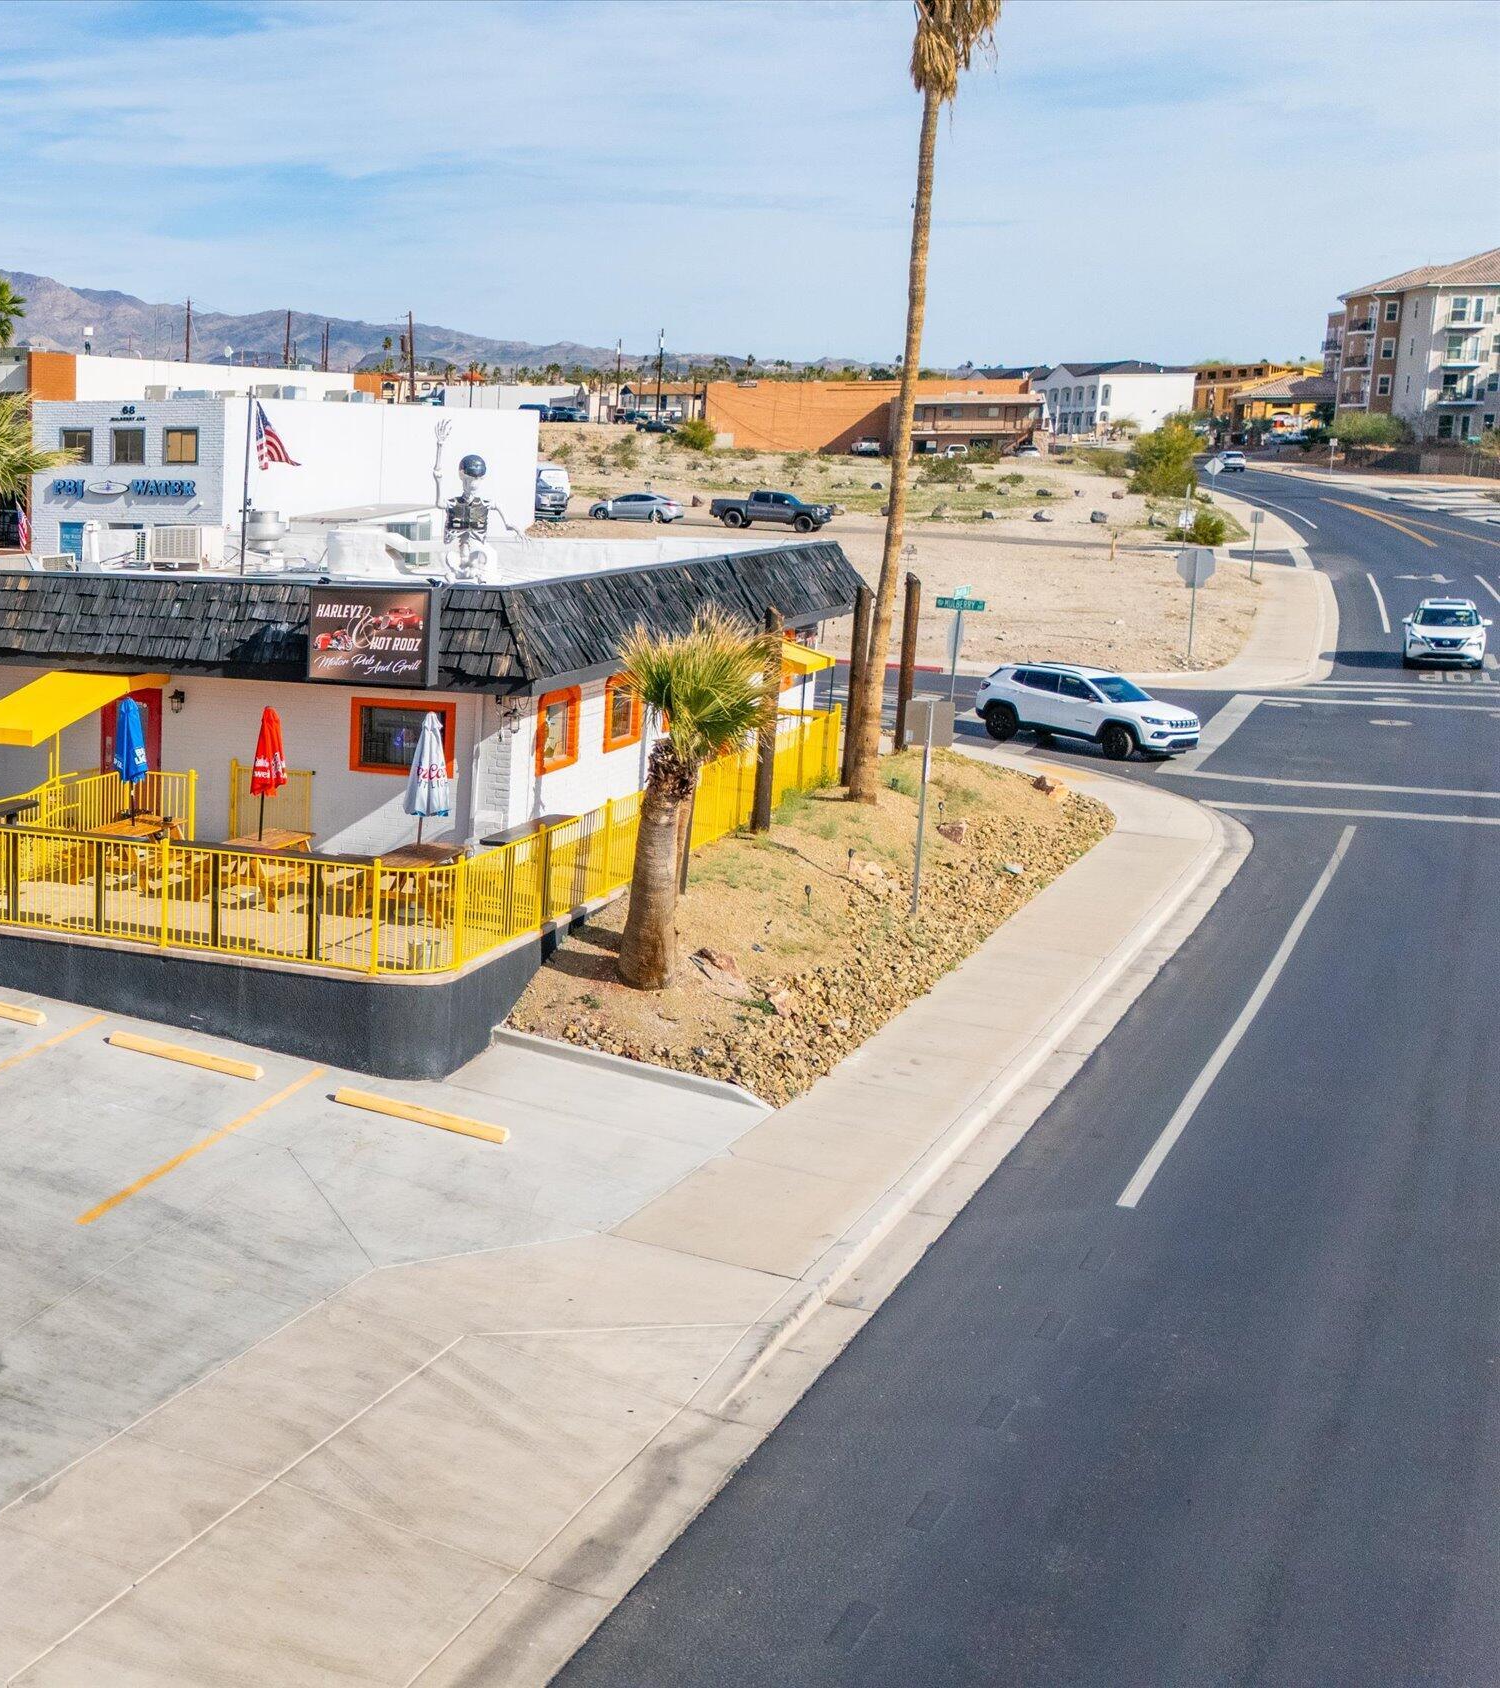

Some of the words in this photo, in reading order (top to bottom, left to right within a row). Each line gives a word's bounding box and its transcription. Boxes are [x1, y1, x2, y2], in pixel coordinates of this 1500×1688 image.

[122, 406, 135, 415] 68
[52, 479, 85, 500] PBJ
[131, 479, 197, 497] WATER
[316, 604, 364, 618] HARLEYZ
[369, 636, 392, 650] HOT
[392, 638, 422, 651] RODZ
[314, 655, 349, 670] Motor
[352, 653, 375, 668] Pub
[363, 661, 393, 675] And
[392, 659, 422, 676] Grill
